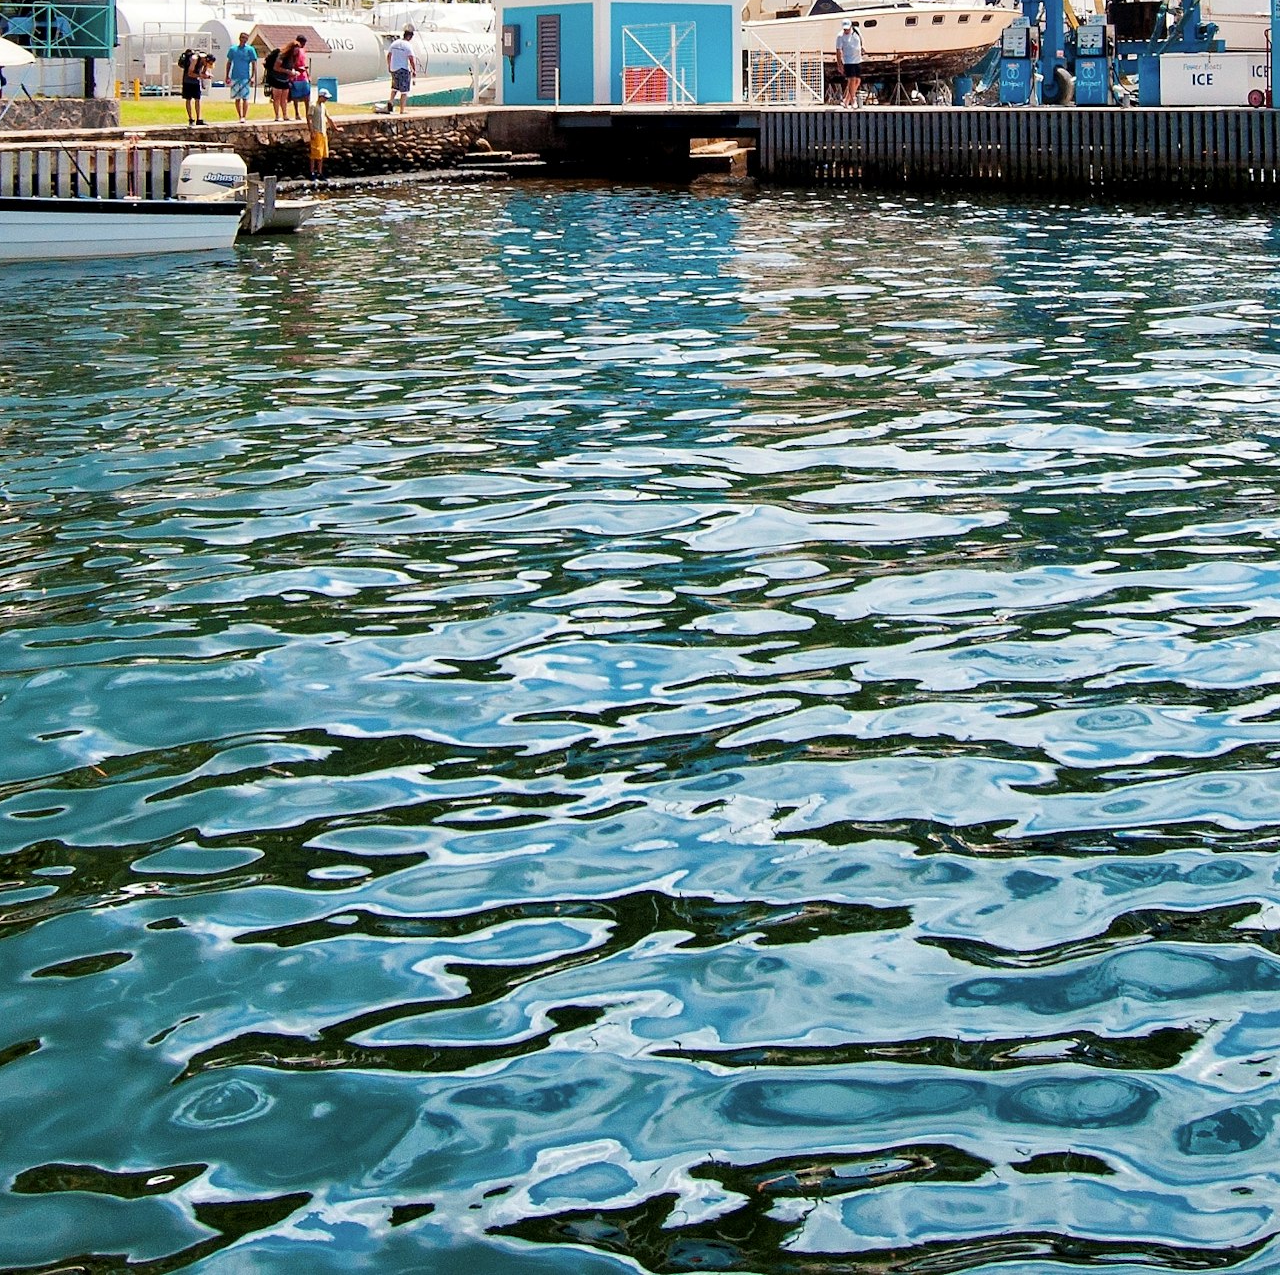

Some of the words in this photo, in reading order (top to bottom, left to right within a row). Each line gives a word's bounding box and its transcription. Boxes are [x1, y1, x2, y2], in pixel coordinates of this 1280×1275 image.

[431, 43, 448, 54] NO
[1192, 73, 1213, 85] ICE
[204, 172, 244, 182] Johnson
